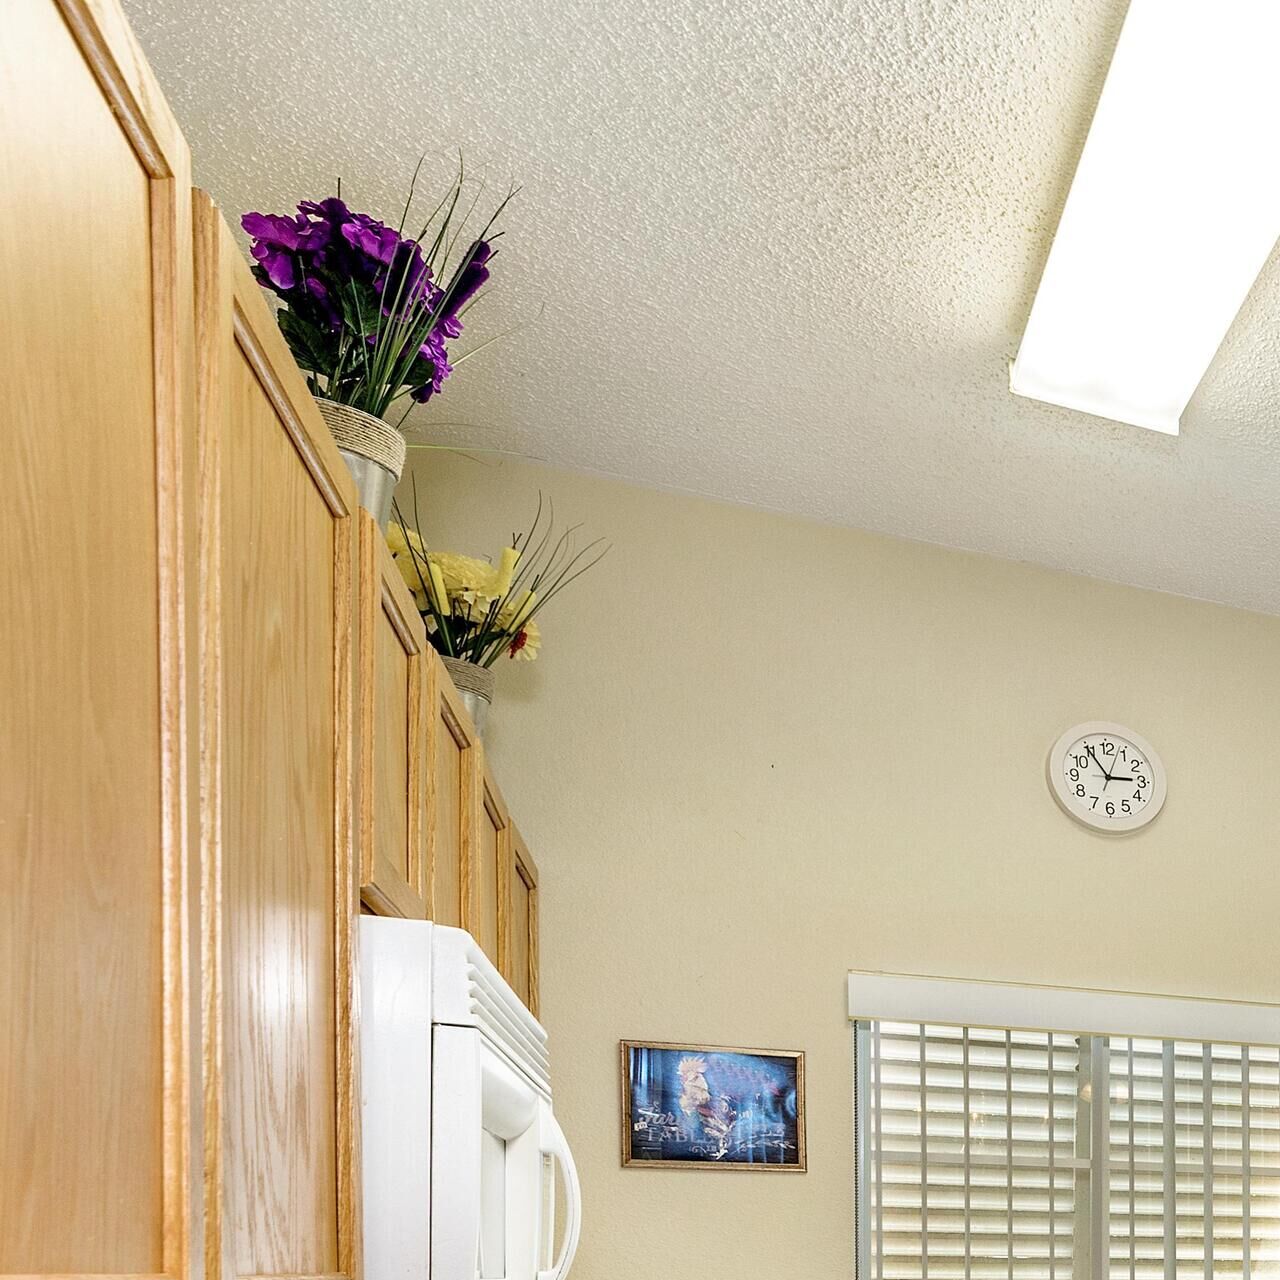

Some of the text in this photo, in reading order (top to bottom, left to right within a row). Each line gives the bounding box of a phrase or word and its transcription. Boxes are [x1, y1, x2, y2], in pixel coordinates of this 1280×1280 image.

[1099, 742, 1115, 756] 12
[1120, 749, 1126, 762] 1
[1072, 755, 1089, 769] 10
[1131, 759, 1140, 773] 2
[1069, 768, 1079, 782] 9
[1137, 775, 1147, 789] 3
[1075, 784, 1086, 798] 8
[1132, 789, 1142, 802] 4
[1089, 796, 1099, 809] 7
[1105, 801, 1115, 815] 6
[1121, 799, 1131, 813] 5
